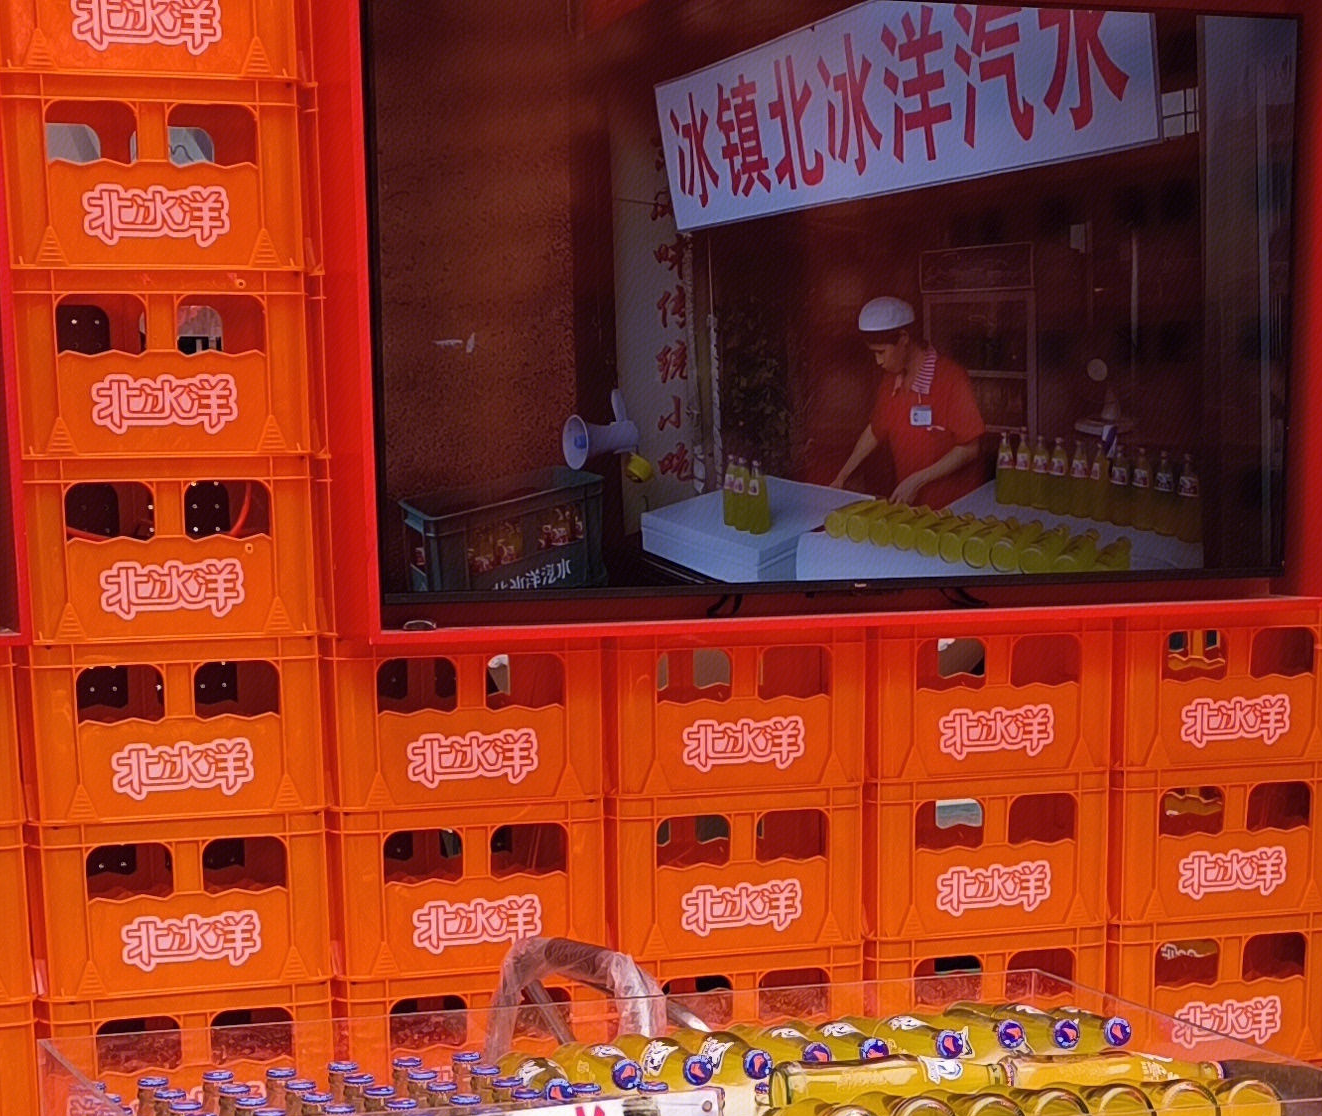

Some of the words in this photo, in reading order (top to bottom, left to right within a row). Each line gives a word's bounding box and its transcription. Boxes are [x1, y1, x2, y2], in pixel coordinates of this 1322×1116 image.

[71, 0, 222, 55] 北冰洋
[670, 4, 1130, 209] 冰镇北冰洋汽水
[82, 184, 230, 247] 北冰洋
[92, 374, 238, 434] 北冰洋
[100, 559, 245, 620] 北冰洋
[683, 716, 805, 772] 北冰洋
[939, 704, 1054, 760] 北冰洋
[1181, 694, 1290, 748] 北冰洋
[112, 738, 254, 800] 北冰洋
[407, 728, 538, 788] 北冰洋
[937, 861, 1051, 916] 北冰洋
[1179, 847, 1287, 900] 北冰洋
[412, 894, 542, 955] 北冰洋
[682, 879, 802, 936] 北冰洋
[121, 910, 262, 972] 北冰洋
[1171, 995, 1282, 1050] 北冰洋
